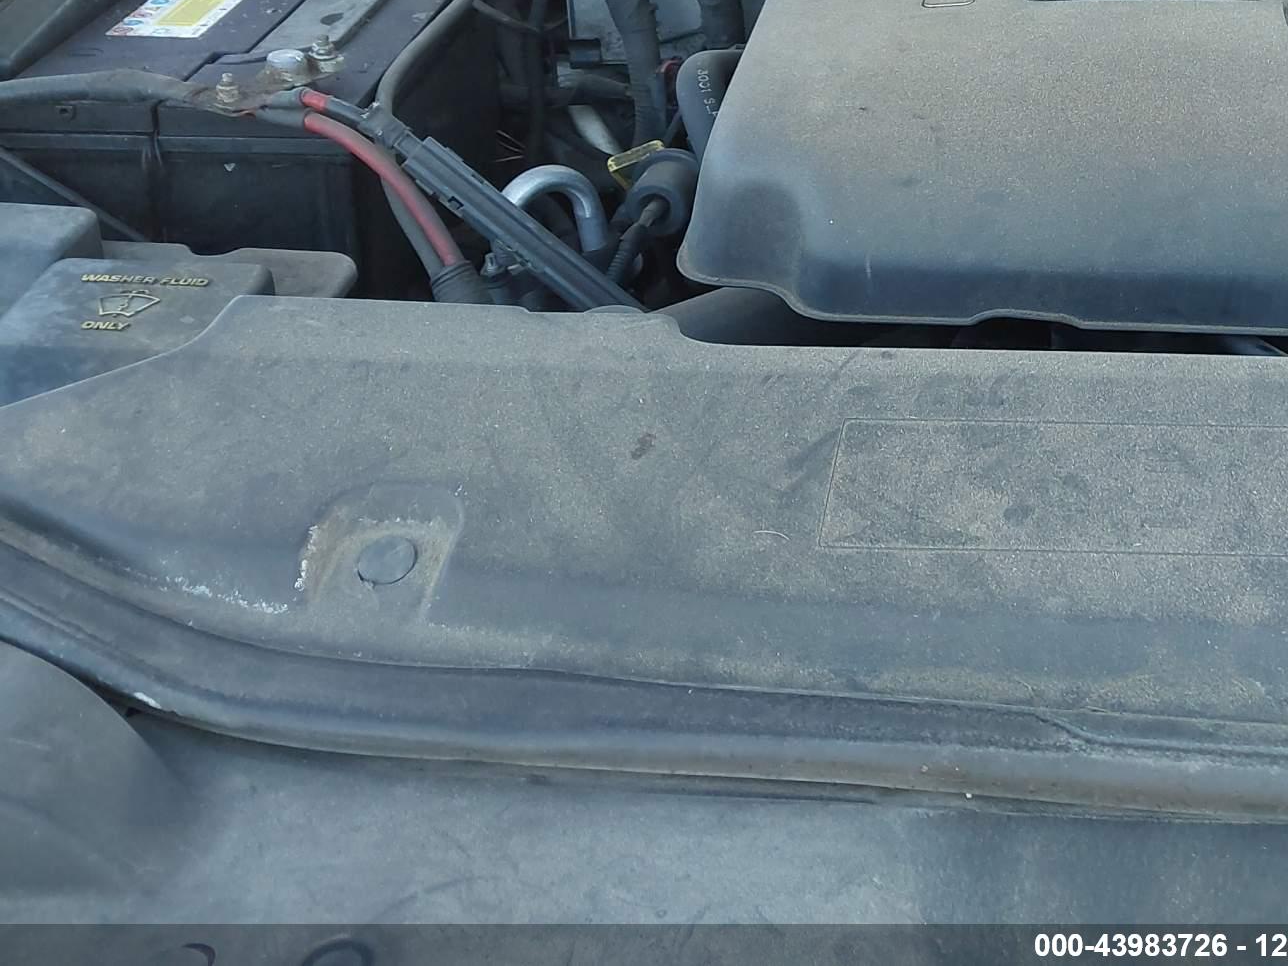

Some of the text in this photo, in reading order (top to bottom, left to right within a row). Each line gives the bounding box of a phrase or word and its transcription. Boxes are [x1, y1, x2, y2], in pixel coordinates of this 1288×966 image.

[81, 274, 209, 287] WASHER FLUID
[81, 320, 131, 332] ONLY
